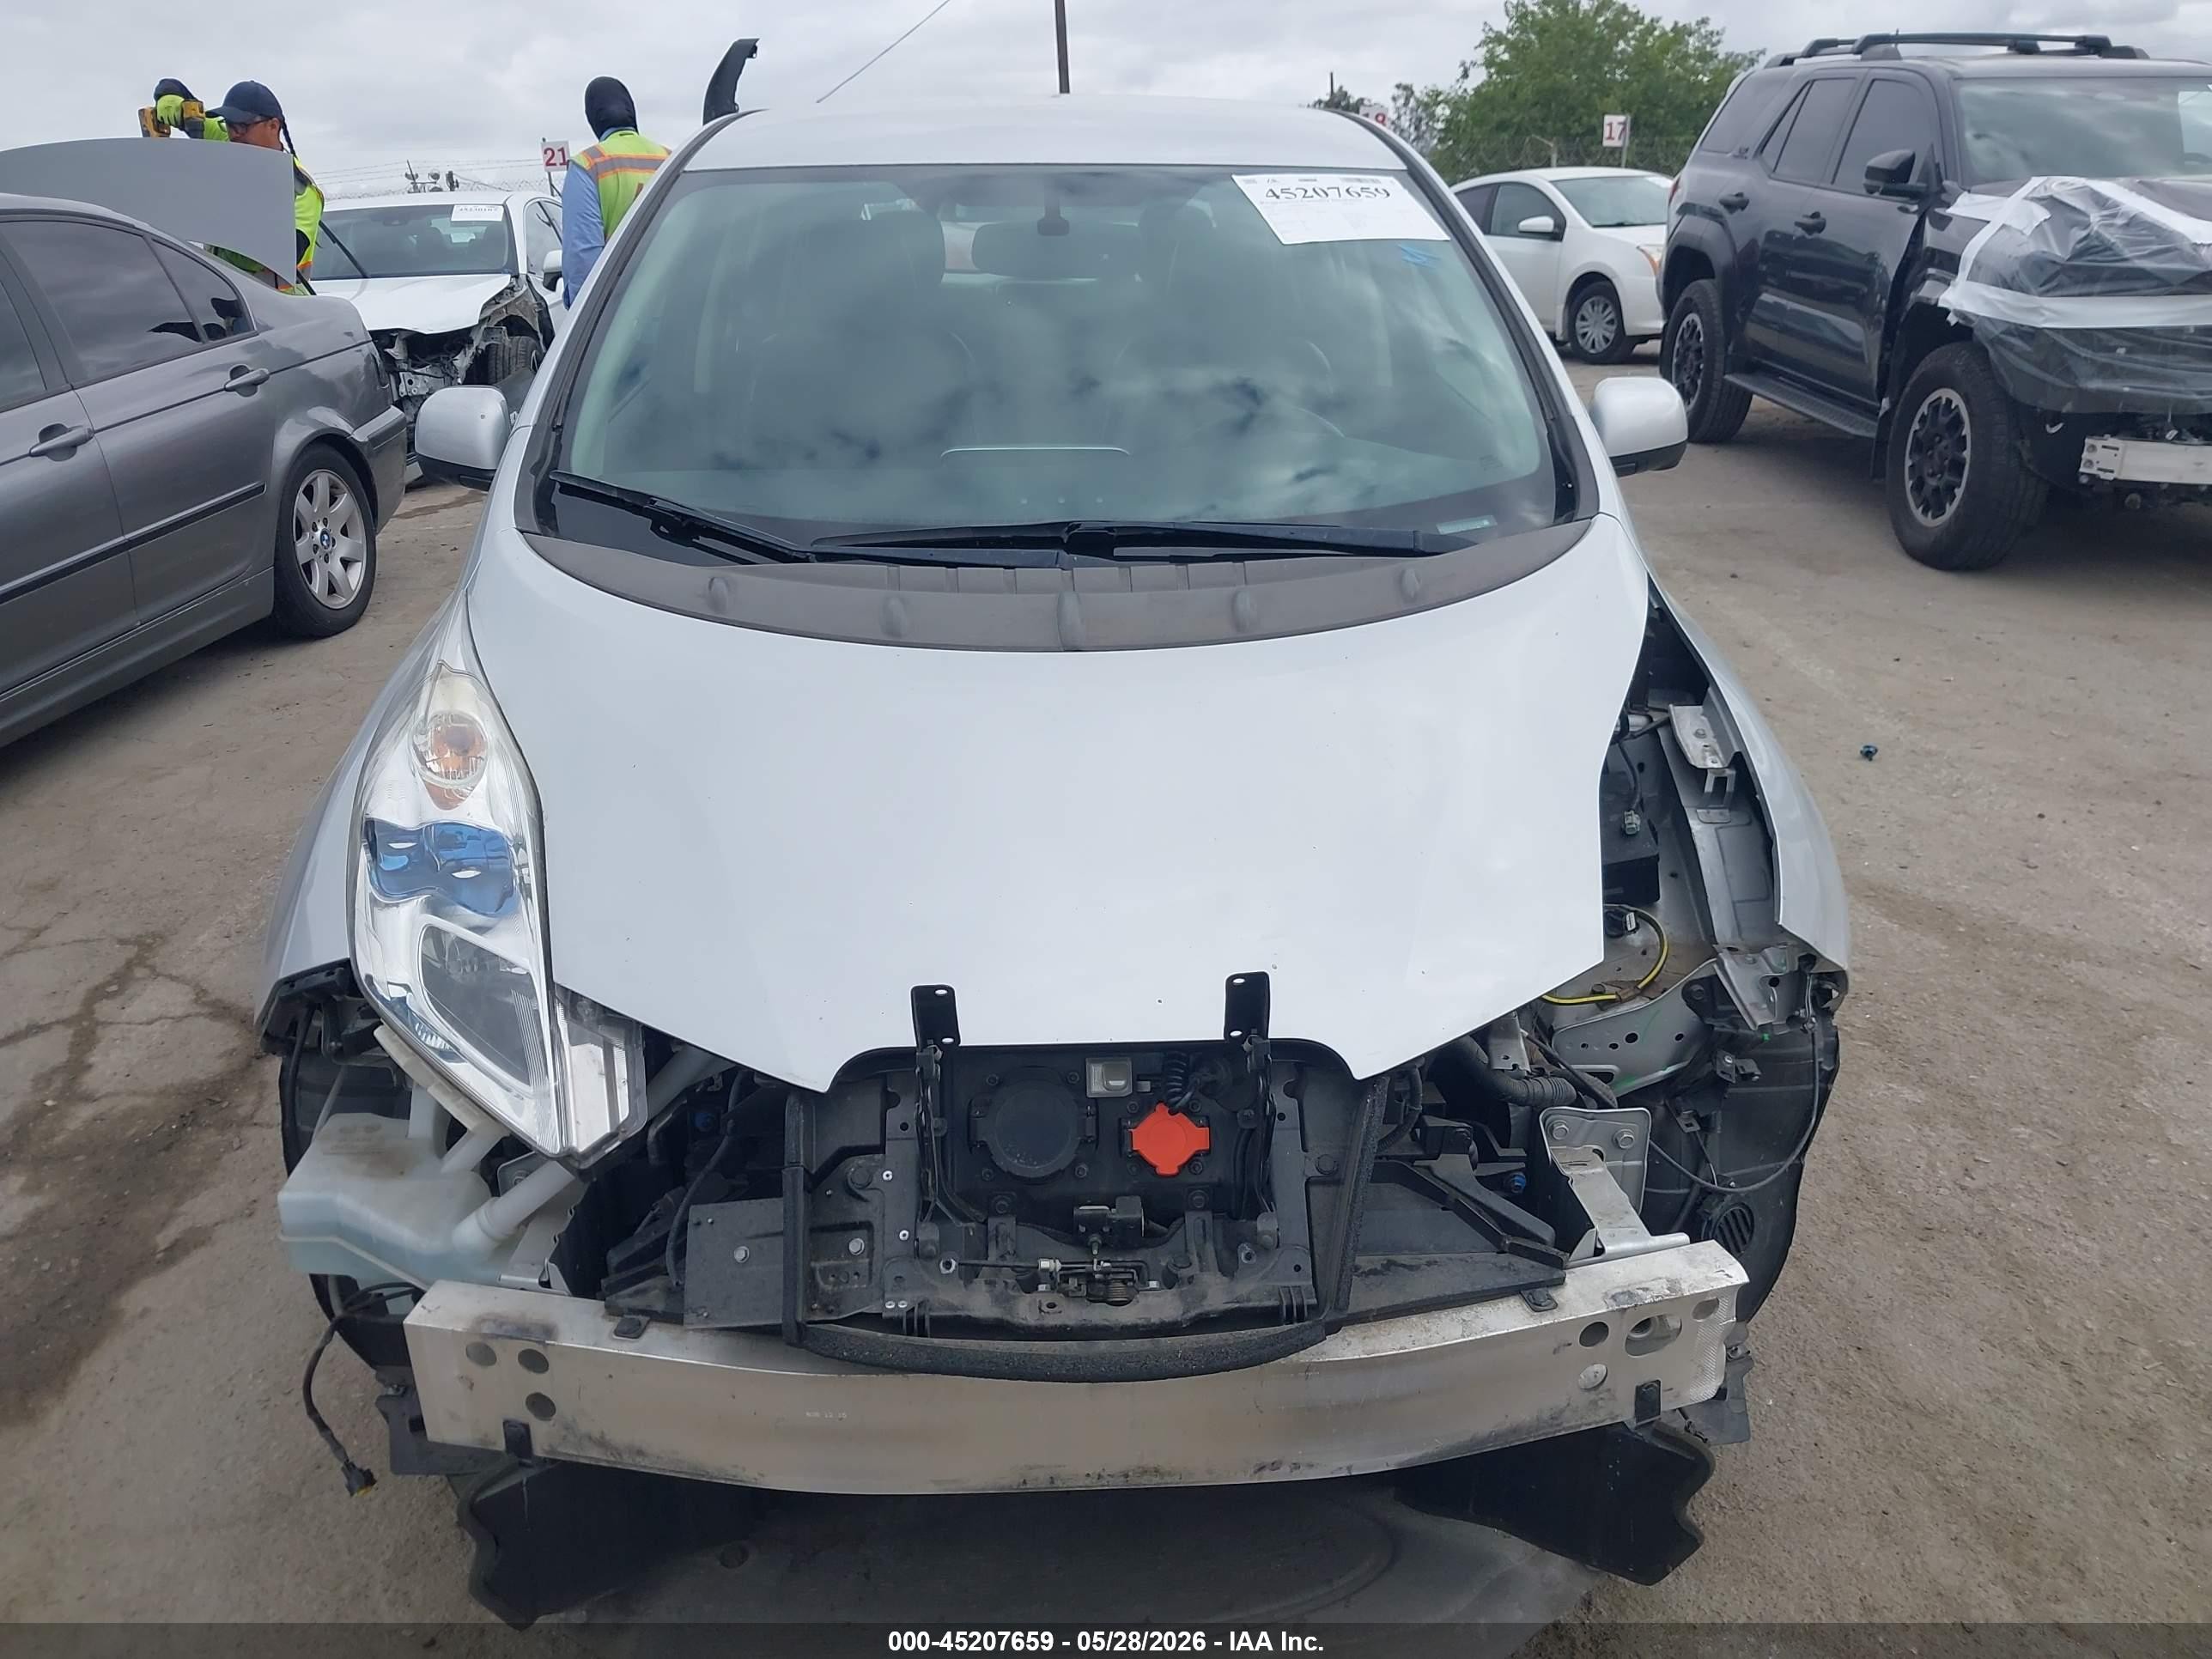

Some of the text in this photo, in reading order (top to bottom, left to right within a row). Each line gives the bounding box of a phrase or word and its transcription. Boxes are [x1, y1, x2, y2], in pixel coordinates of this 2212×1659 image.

[1606, 122, 1627, 141] 17
[544, 147, 568, 167] 21
[1265, 185, 1390, 200] 45207659
